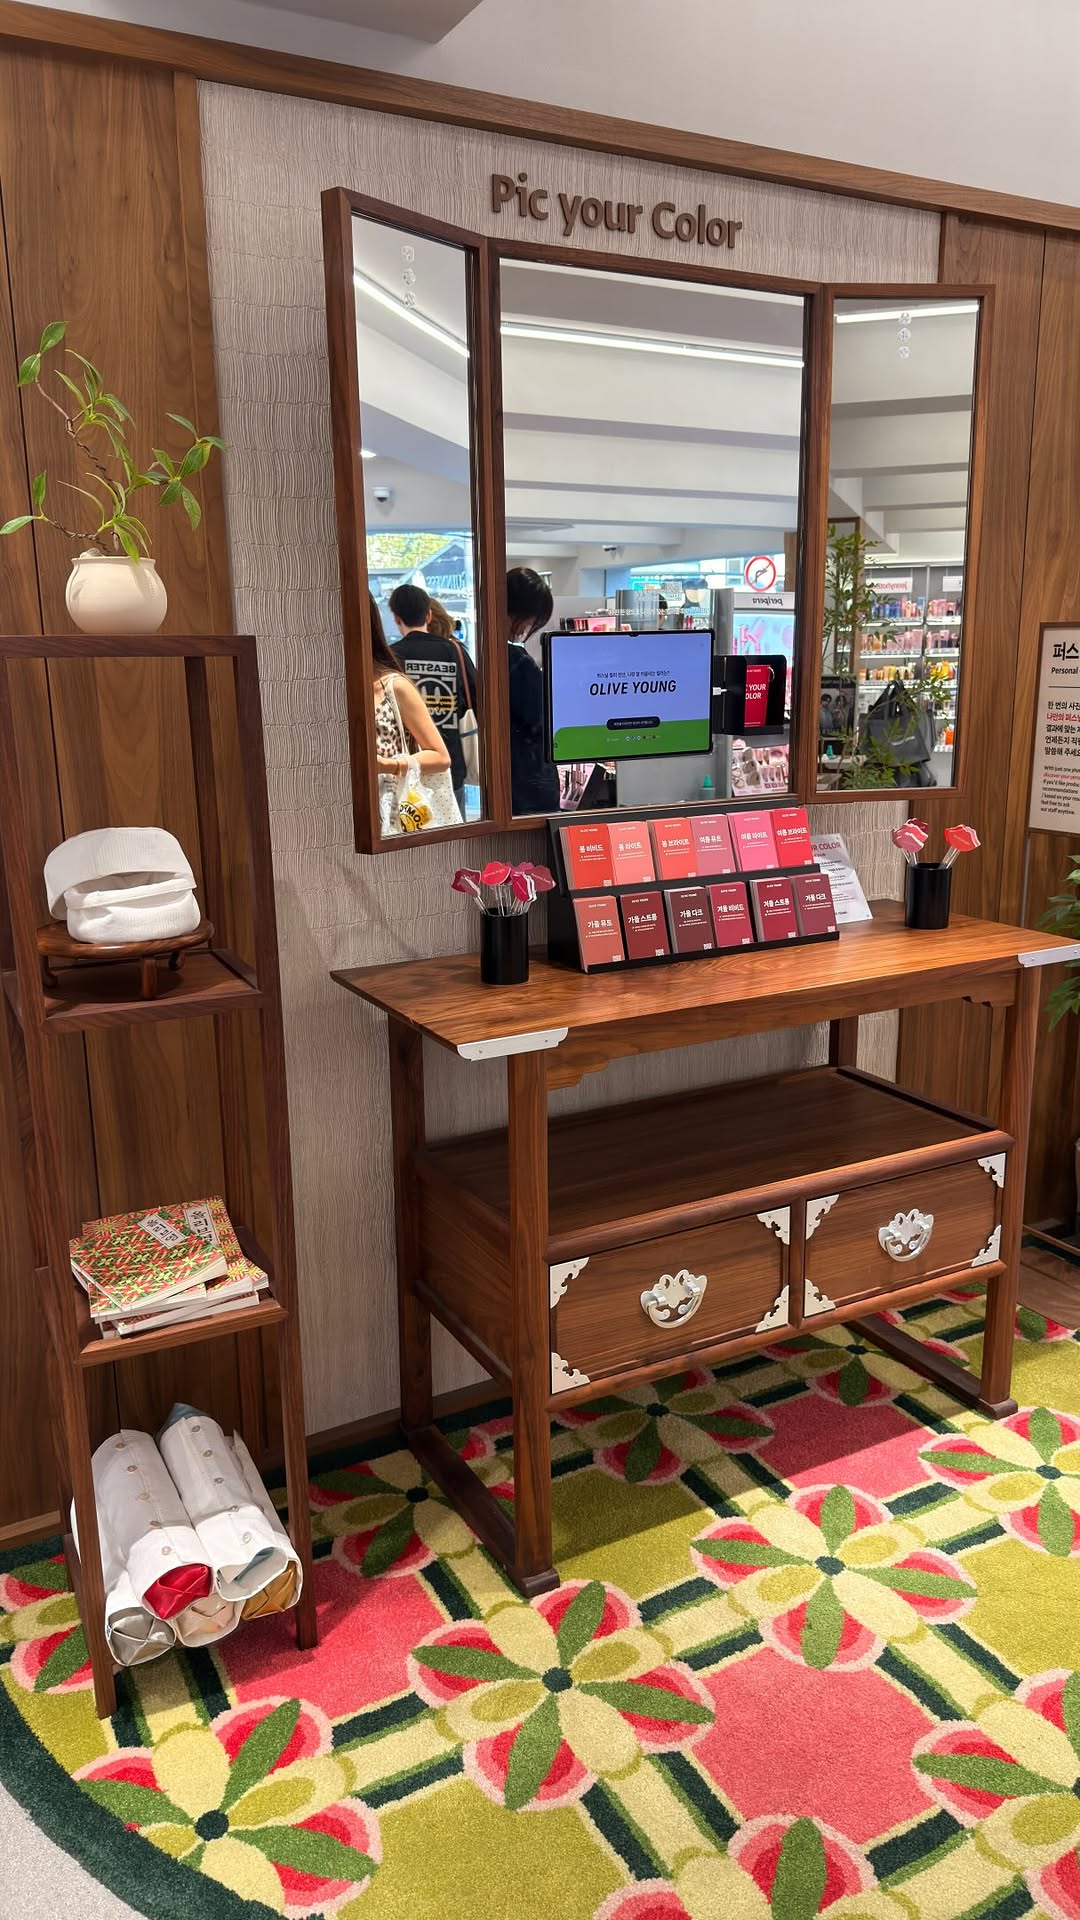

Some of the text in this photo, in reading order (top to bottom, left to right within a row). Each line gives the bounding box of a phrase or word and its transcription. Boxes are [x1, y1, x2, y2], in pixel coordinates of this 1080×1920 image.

[491, 172, 742, 248] Pic your Color
[1051, 666, 1078, 675] Personal
[590, 680, 677, 696] OLIVE YOUNG
[749, 683, 767, 691] YOUR
[787, 827, 808, 836] 브라이트
[586, 844, 604, 852] 비비드
[820, 842, 840, 850] COLOR
[816, 892, 827, 900] 다크
[680, 908, 704, 918] 가을 다크
[628, 913, 657, 924] 가을 스트롱
[588, 919, 600, 929] 가을
